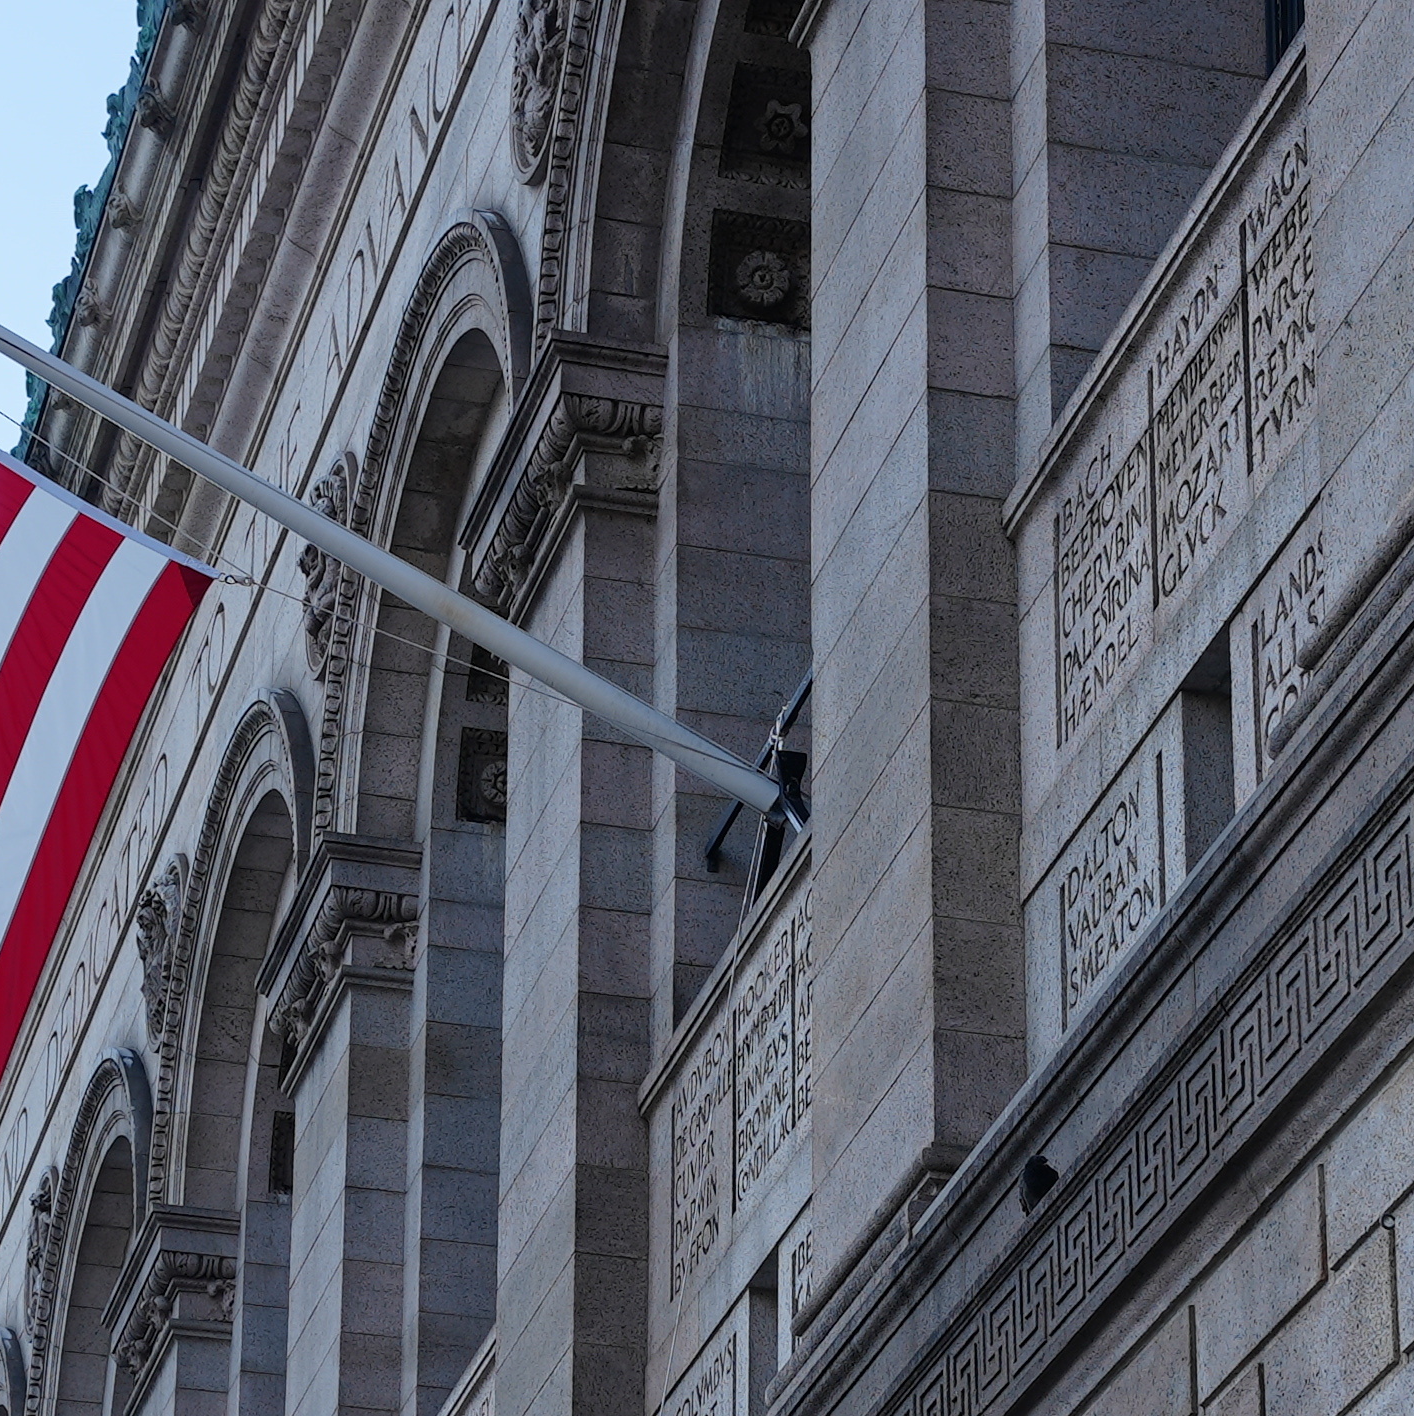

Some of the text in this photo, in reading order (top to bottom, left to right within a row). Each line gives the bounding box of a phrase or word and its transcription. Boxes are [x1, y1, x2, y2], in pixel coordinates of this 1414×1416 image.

[1156, 264, 1223, 387] HAYDN
[1159, 350, 1242, 483] MEYERBEER
[1160, 396, 1243, 553] MOZART
[1063, 434, 1111, 539] BACH
[1161, 480, 1227, 599] GLVCK
[44, 753, 168, 1117] DEDICATED
[191, 602, 226, 730] TO
[322, 0, 482, 421] ADVANCE
[1063, 543, 1150, 693] PALESTRINA
[1068, 781, 1140, 911] DALTON
[737, 929, 789, 1031] HOOKER
[1070, 870, 1156, 1011] SMEATON
[738, 1066, 788, 1164] BROWNE
[738, 1105, 791, 1201] CONDILLAC
[676, 1166, 717, 1252] DARWIN
